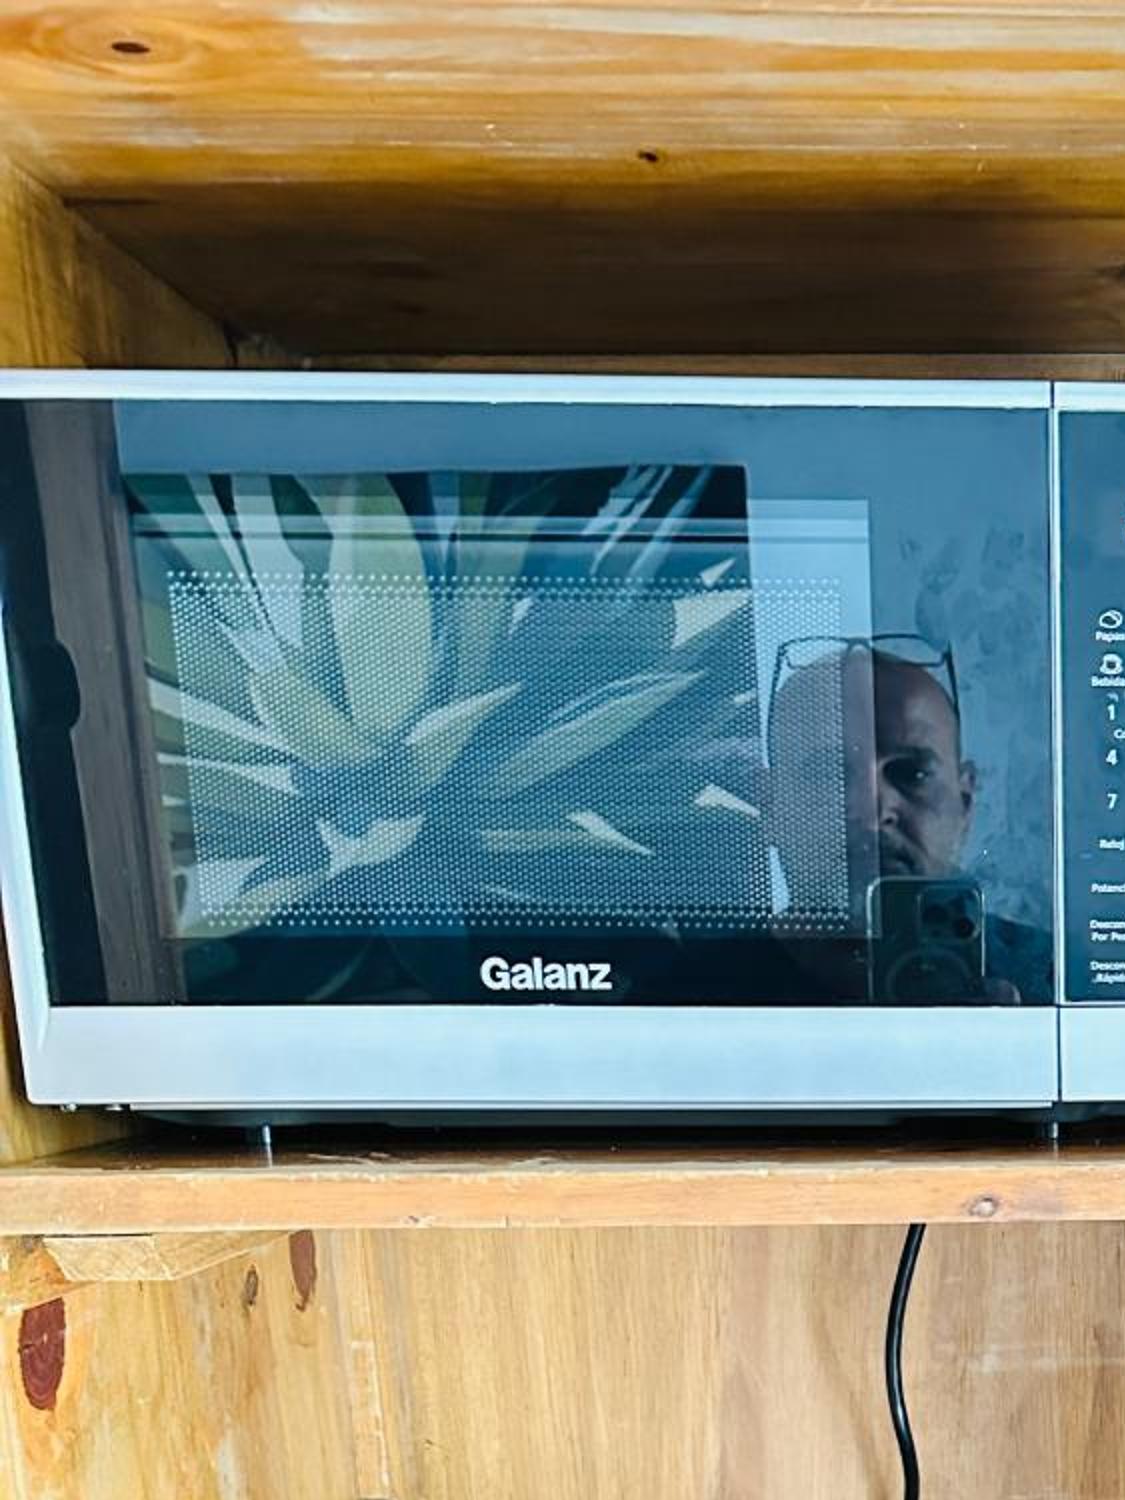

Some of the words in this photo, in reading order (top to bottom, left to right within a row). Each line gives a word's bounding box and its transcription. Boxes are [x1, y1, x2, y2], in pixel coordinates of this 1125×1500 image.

[1107, 704, 1115, 721] 1
[1105, 749, 1118, 765] 4
[1107, 793, 1118, 809] 7
[479, 957, 612, 991] Galanz
